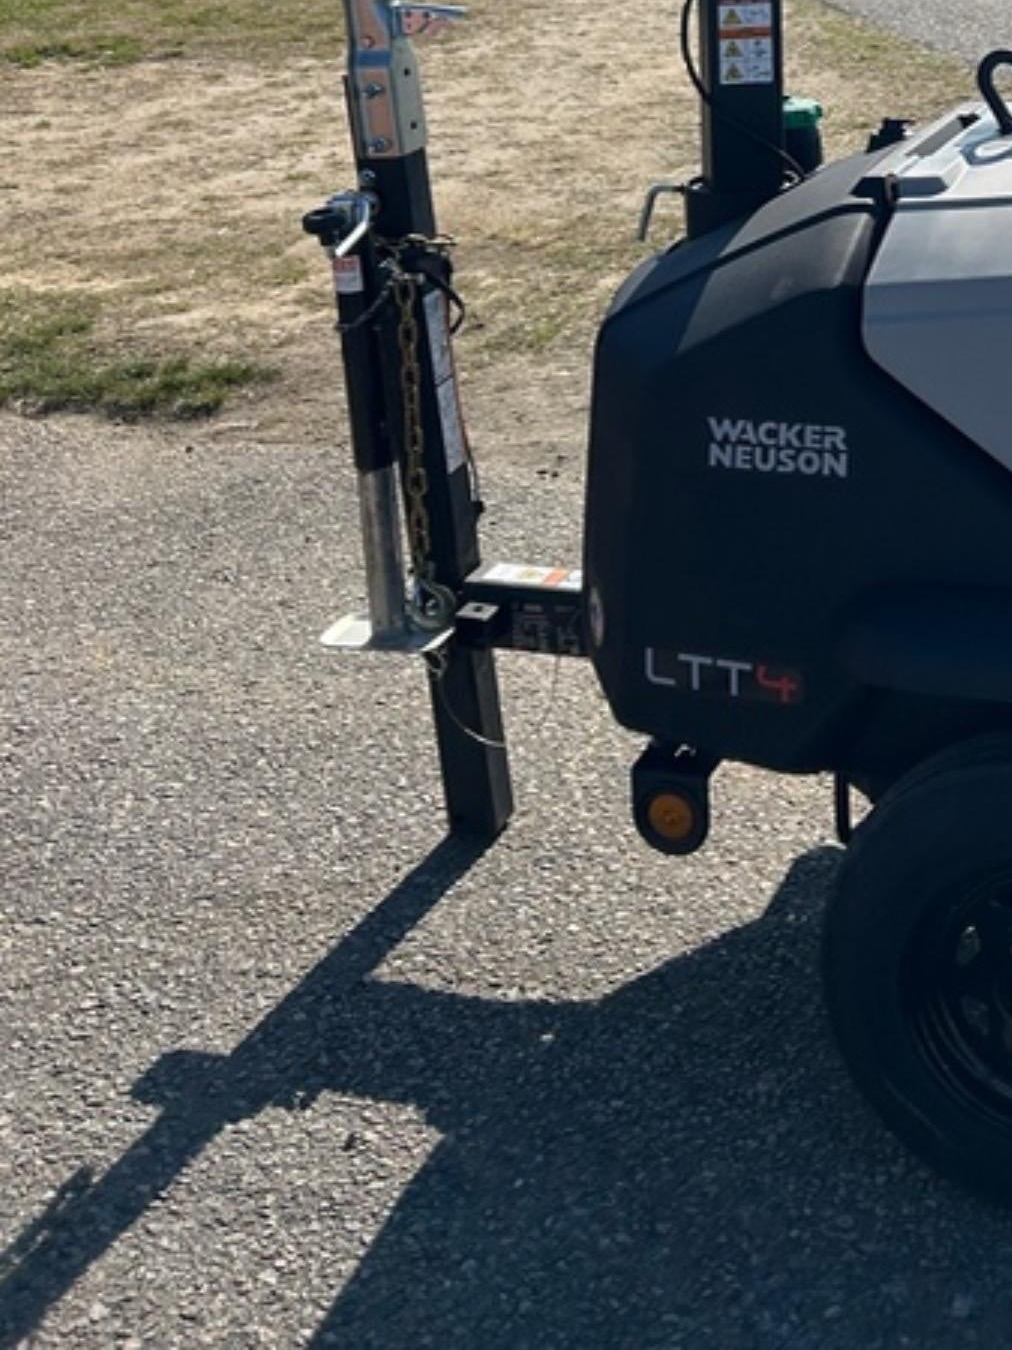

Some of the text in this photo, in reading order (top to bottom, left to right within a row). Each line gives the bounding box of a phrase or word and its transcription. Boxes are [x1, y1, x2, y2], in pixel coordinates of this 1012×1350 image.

[706, 416, 848, 450] WACKER
[708, 444, 849, 478] NEUSON
[644, 647, 799, 704] LTT4
